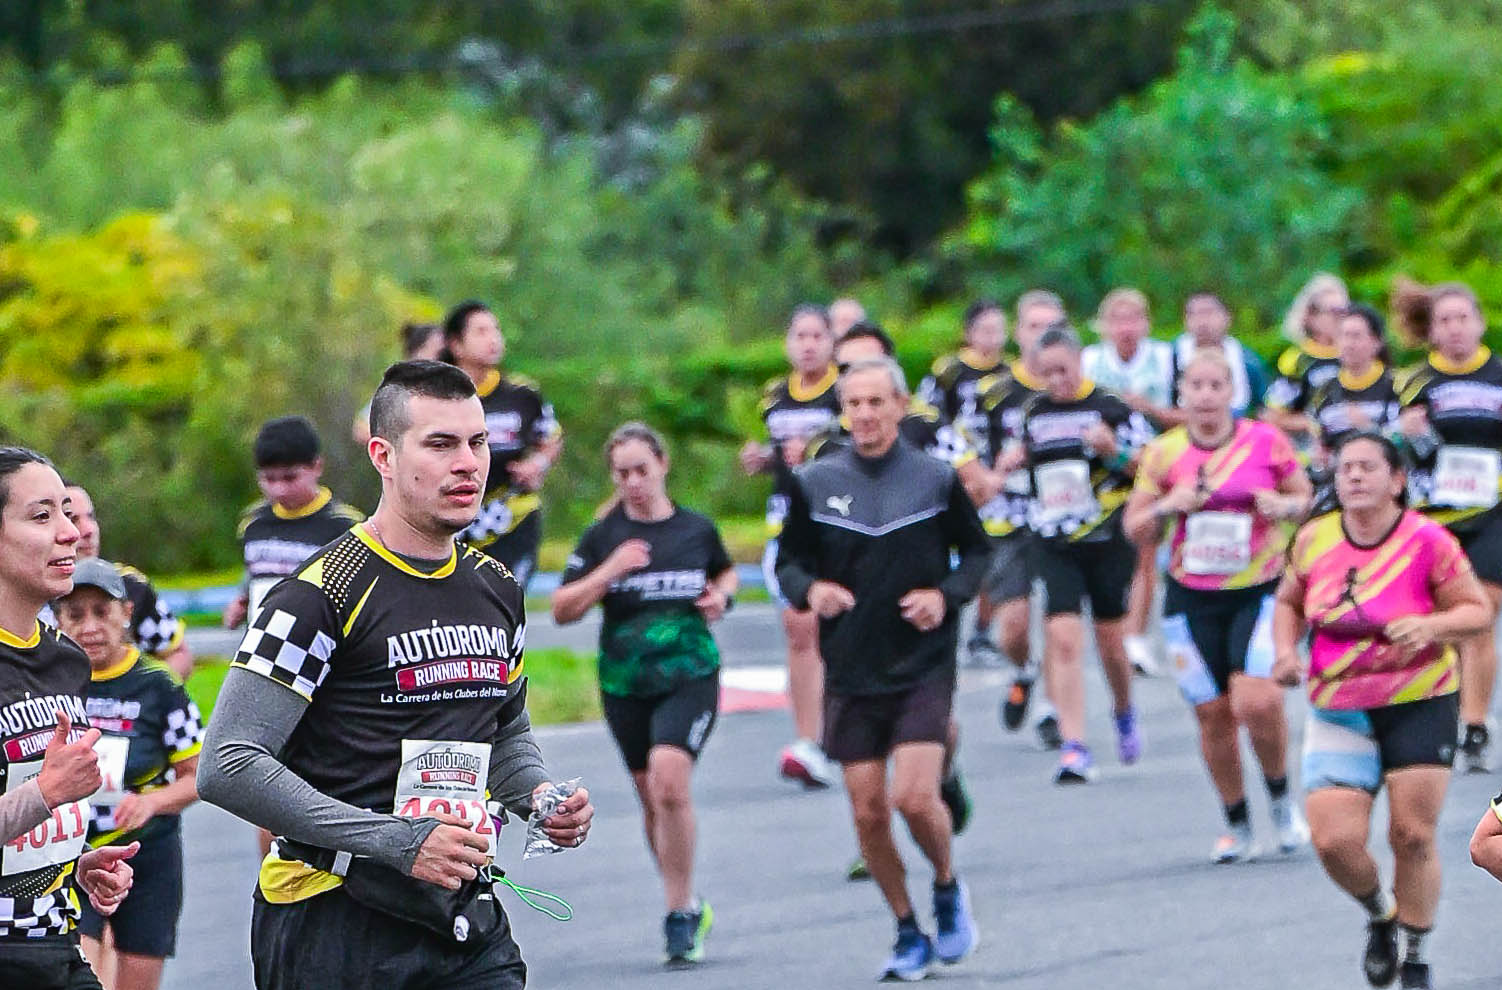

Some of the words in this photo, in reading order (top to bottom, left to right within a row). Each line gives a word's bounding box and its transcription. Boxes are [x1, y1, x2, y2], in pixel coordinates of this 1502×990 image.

[387, 619, 510, 668] AUTÓDROMO
[413, 661, 468, 687] RUNNING
[470, 660, 501, 681] RACE
[381, 693, 393, 703] La
[396, 693, 430, 703] Carrera
[432, 690, 441, 701] de
[443, 689, 453, 700] los
[455, 687, 478, 699] Clubes
[480, 686, 491, 698] del
[0, 691, 89, 739] AUTÓDROM
[19, 731, 57, 757] RUNN
